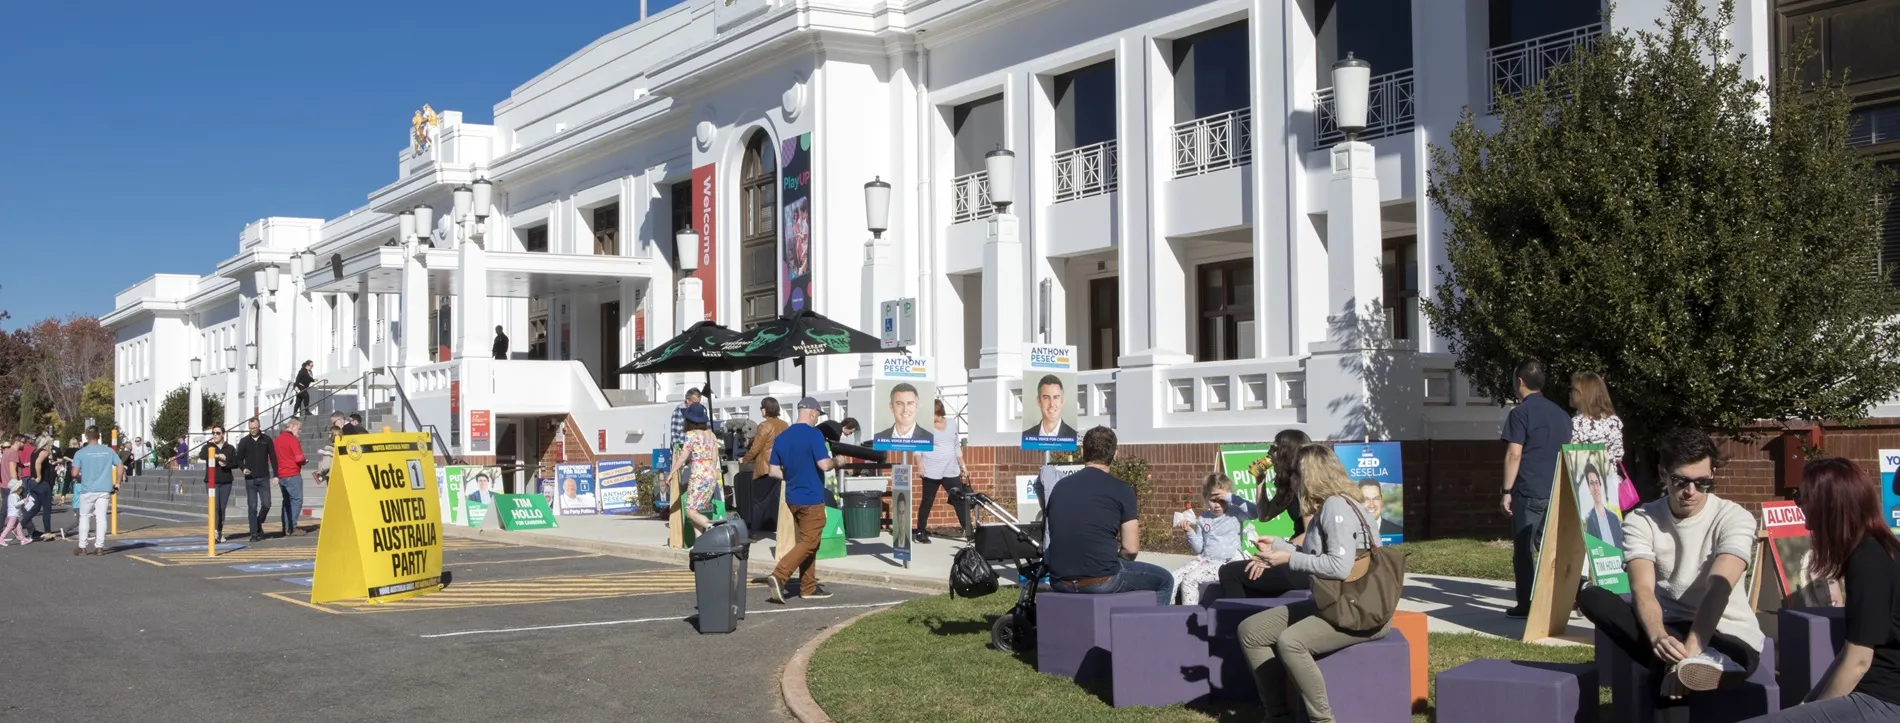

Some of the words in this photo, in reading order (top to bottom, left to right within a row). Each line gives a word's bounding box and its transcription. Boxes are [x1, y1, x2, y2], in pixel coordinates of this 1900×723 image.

[703, 175, 712, 266] Welcome
[1031, 347, 1069, 356] ANTHONY
[884, 358, 926, 366] ANTHONY
[1031, 354, 1056, 363] PESEC
[884, 364, 911, 373] PESEC
[1357, 458, 1380, 467] ZED
[366, 463, 405, 490] Vote
[412, 463, 420, 487] 1
[1350, 468, 1388, 477] SESELJA
[512, 498, 532, 508] TIM
[380, 497, 426, 524] UNITED
[511, 509, 543, 519] HOLLO
[1768, 508, 1804, 524] ALICIA
[373, 523, 437, 552] AUSTRALIA
[392, 550, 427, 578] PARTY
[1596, 561, 1606, 571] TIM
[1606, 560, 1621, 570] HOLLO
